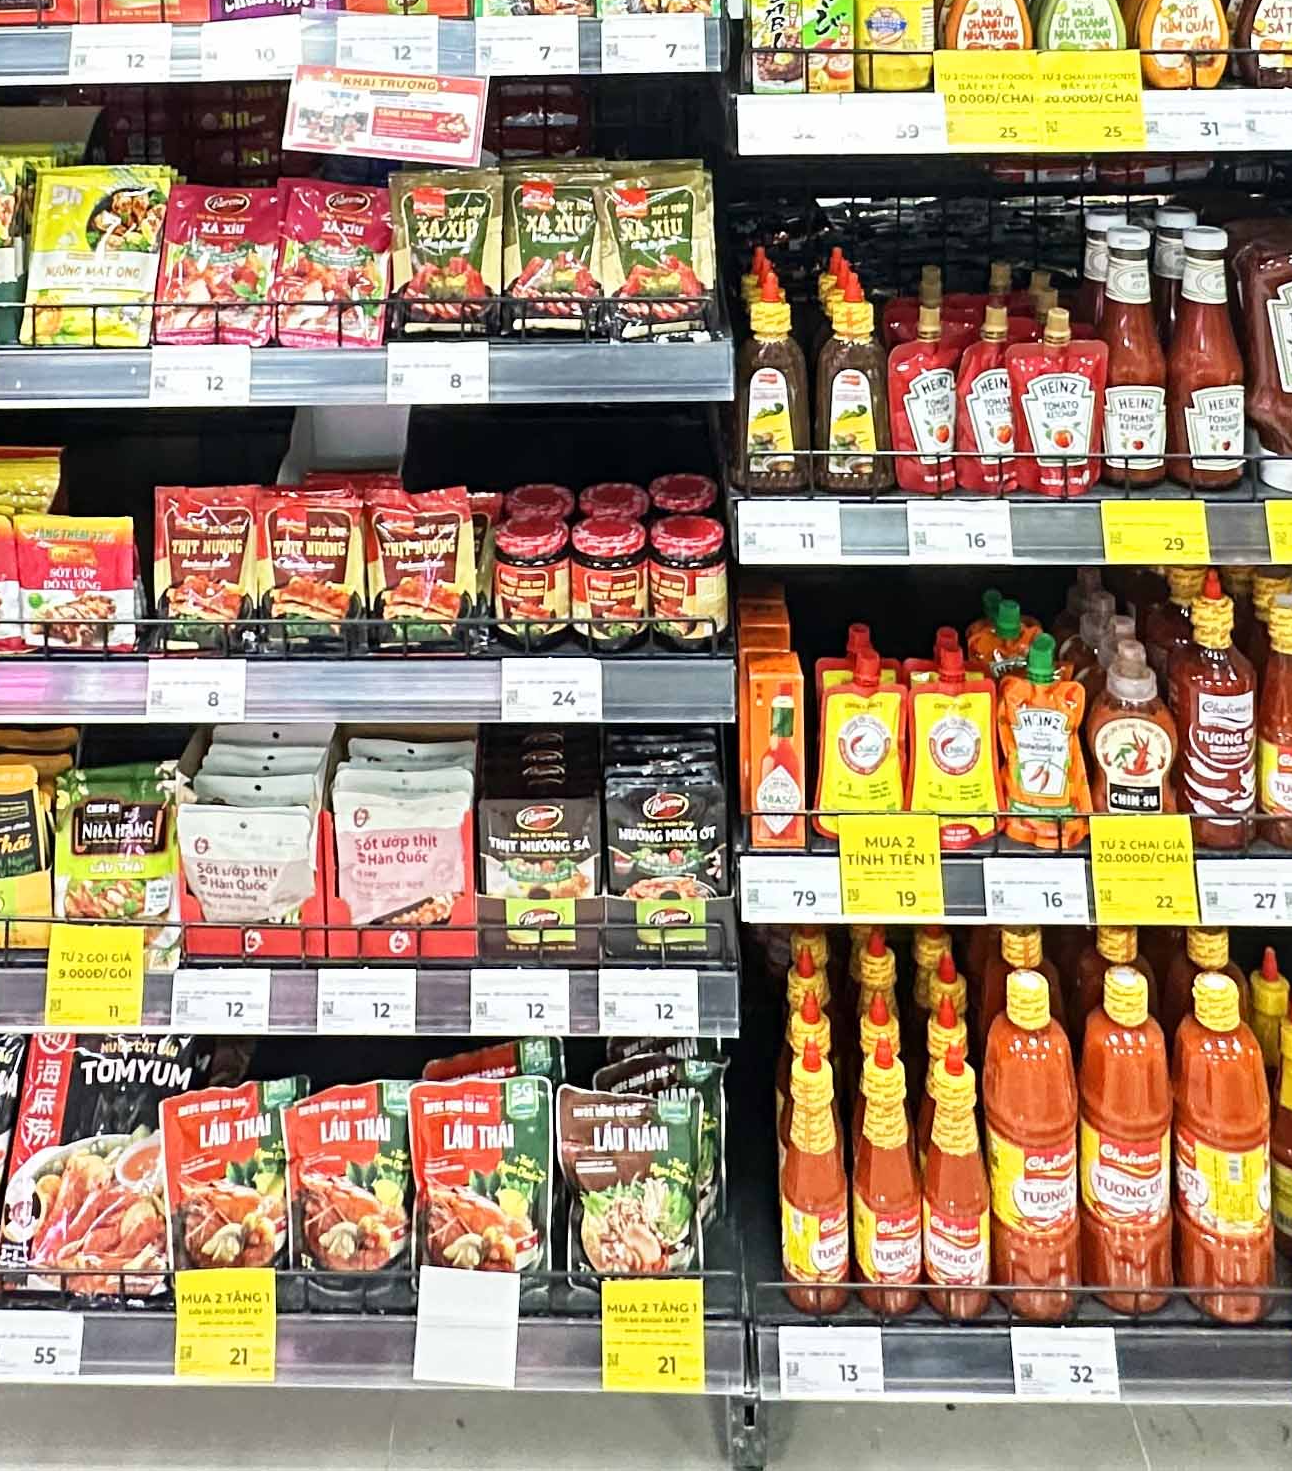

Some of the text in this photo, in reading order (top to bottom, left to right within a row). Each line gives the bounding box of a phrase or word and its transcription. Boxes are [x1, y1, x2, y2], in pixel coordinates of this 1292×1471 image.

[539, 46, 551, 60] 7
[1200, 122, 1219, 136] 31
[450, 374, 461, 388] 8
[1040, 379, 1077, 396] HEINZ
[1043, 401, 1078, 412] TOMATO
[966, 533, 986, 548] 16
[1164, 538, 1184, 550] 29
[553, 691, 576, 706] 24
[1111, 793, 1158, 806] CHIN-SU
[865, 836, 915, 849] MUA 2
[846, 852, 884, 866] TÍNH
[930, 853, 935, 865] 1
[793, 891, 816, 906] 79
[896, 891, 916, 907] 19
[1254, 893, 1276, 909] 27
[226, 1002, 243, 1017] 12
[82, 1060, 192, 1090] TOMYUM
[182, 1293, 211, 1304] MUA
[215, 1293, 222, 1304] 2
[264, 1294, 269, 1303] 1
[230, 1348, 247, 1365] 21
[1070, 1366, 1093, 1383] 32
